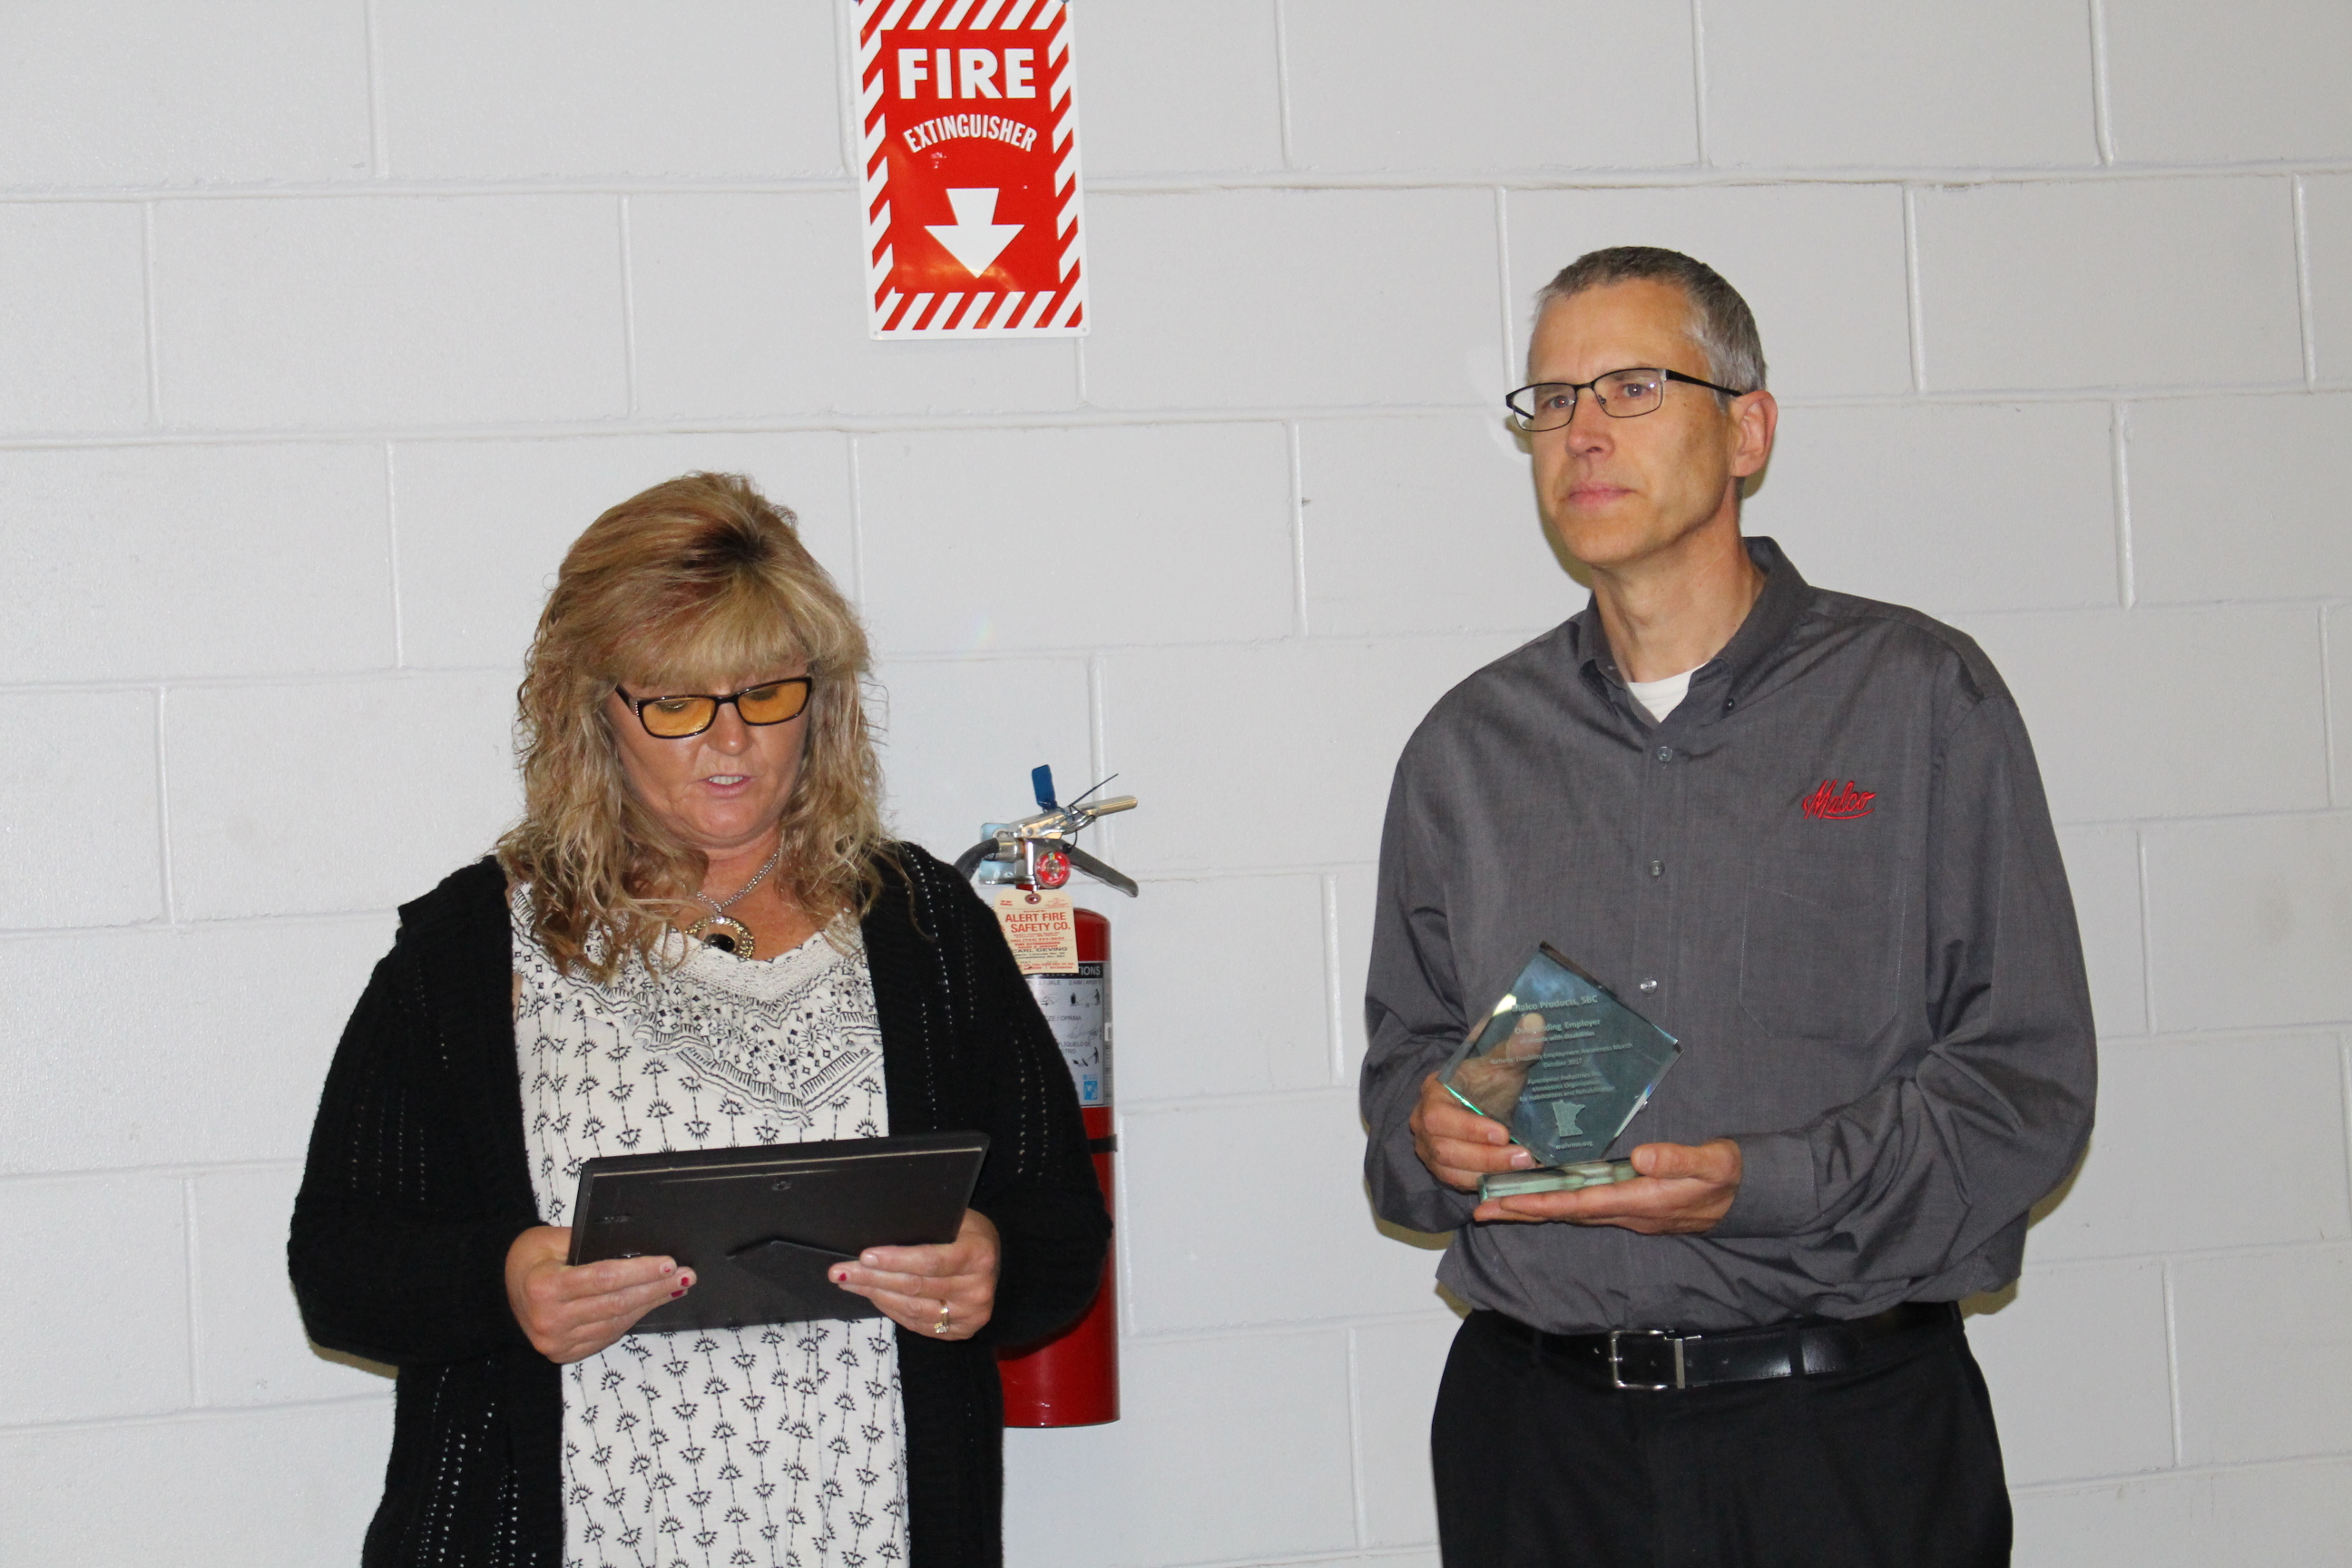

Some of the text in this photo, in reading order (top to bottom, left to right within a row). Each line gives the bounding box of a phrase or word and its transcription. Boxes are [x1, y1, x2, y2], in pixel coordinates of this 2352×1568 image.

[897, 48, 1036, 100] FIRE
[902, 113, 1038, 153] EXTINGUISHER
[1801, 779, 1877, 820] Malco
[1005, 912, 1067, 922] ALERT FIRE
[1011, 921, 1071, 933] SAFETY CO.
[1539, 998, 1579, 1009] Products,
[1581, 995, 1598, 1004] SBC
[1565, 1019, 1601, 1029] Employer
